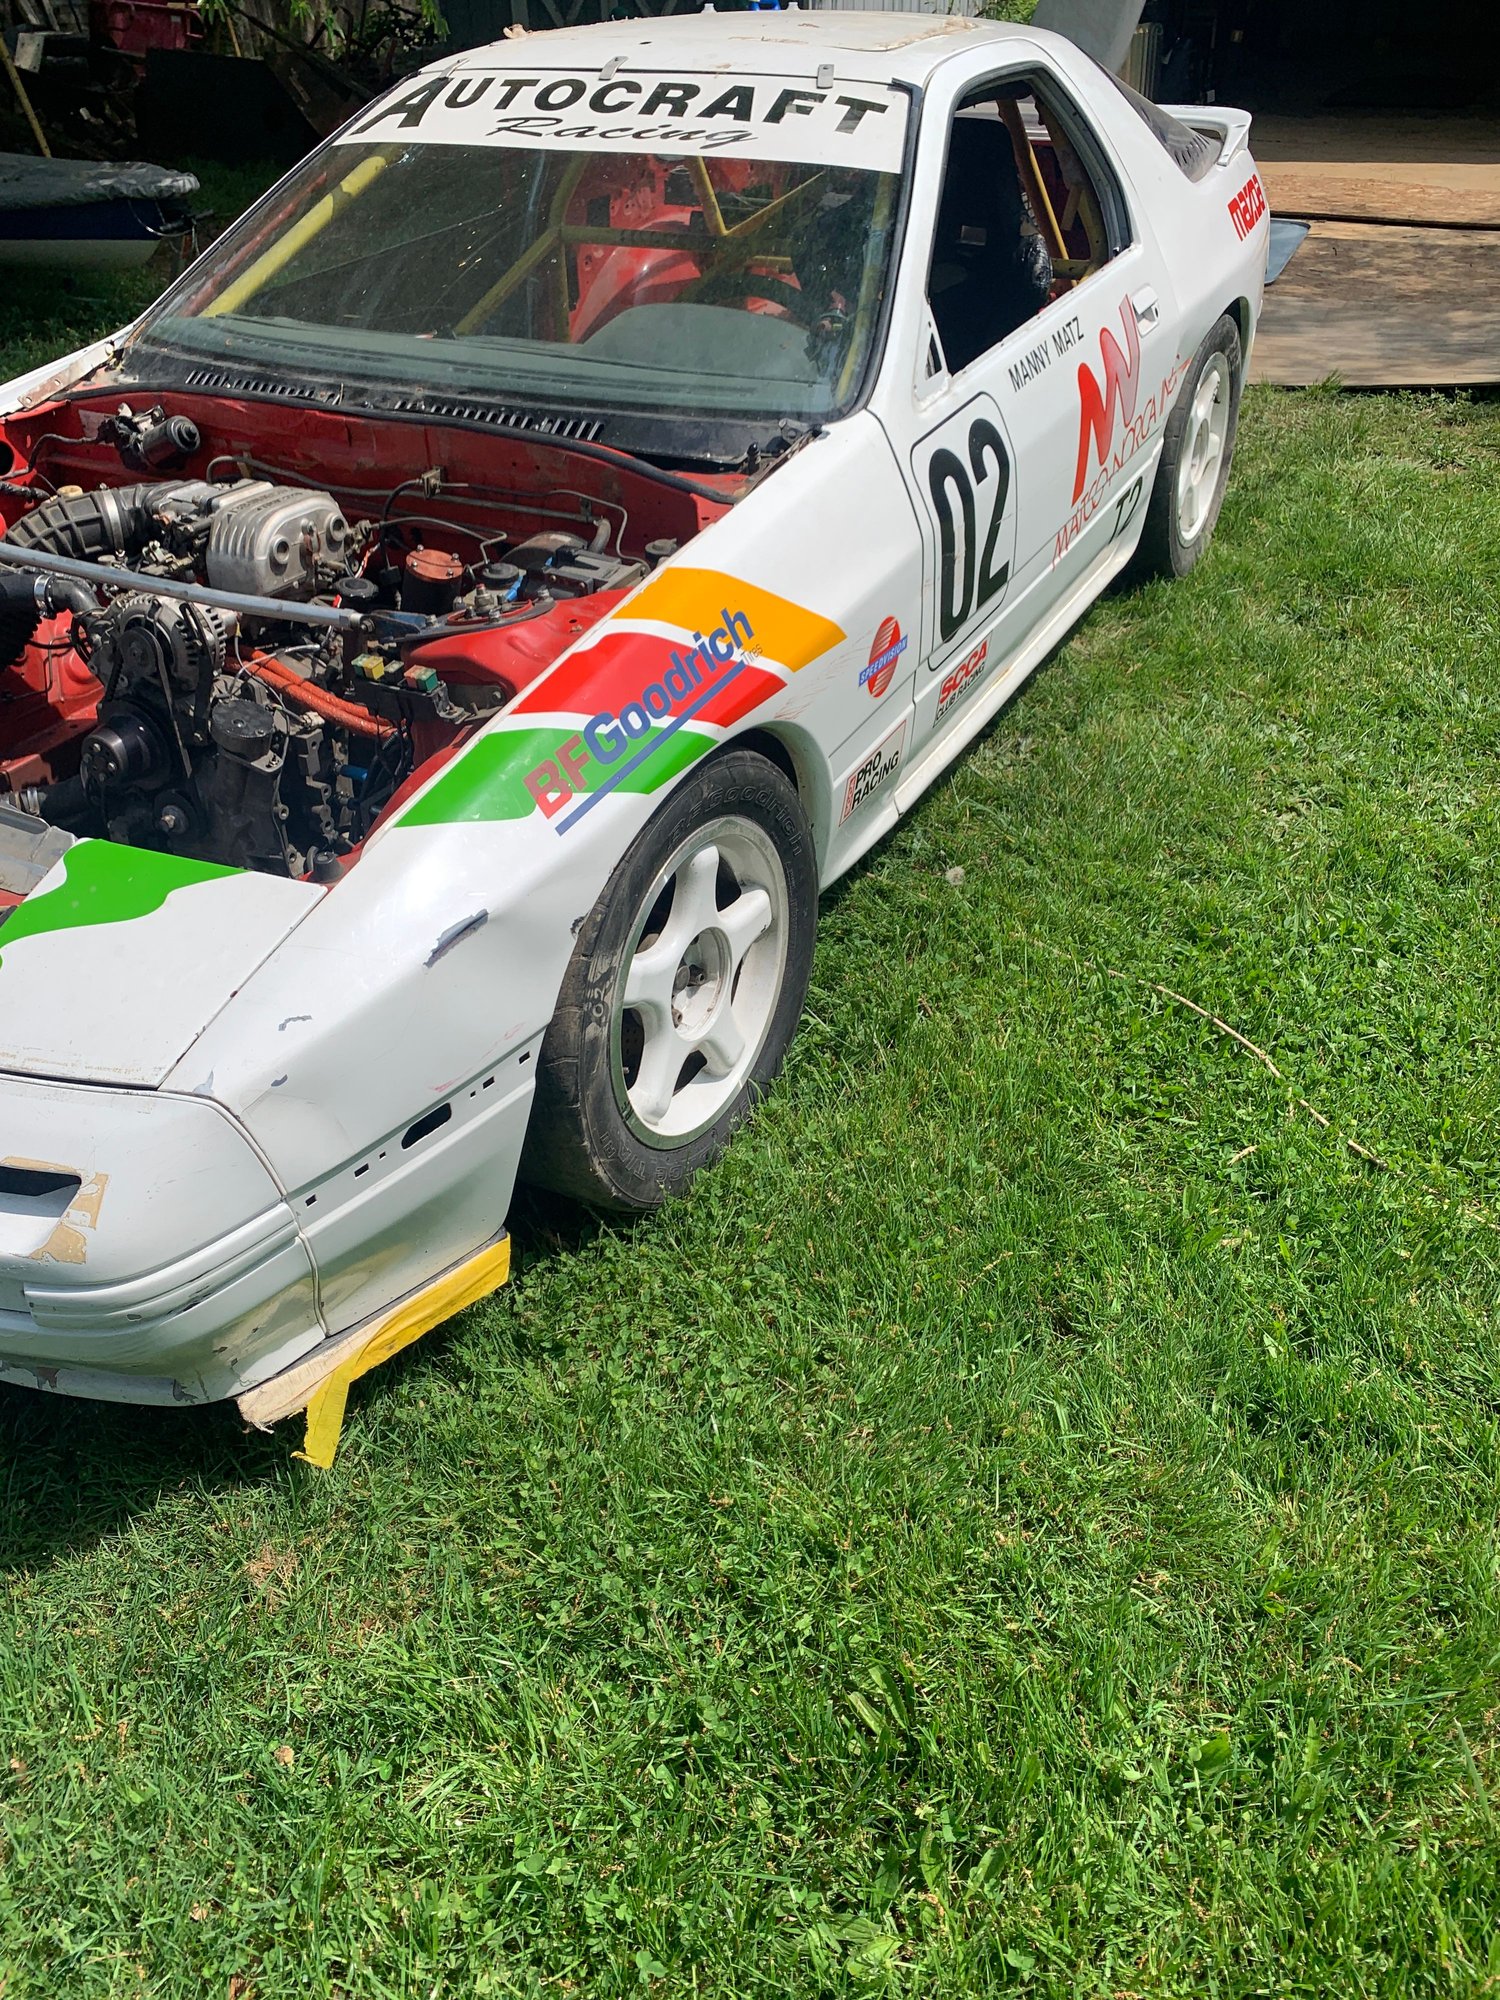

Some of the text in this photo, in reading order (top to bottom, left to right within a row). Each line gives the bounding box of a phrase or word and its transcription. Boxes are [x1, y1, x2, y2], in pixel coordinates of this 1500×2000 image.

[348, 76, 888, 137] AUTOCRAFT
[486, 117, 760, 149] Racing
[1008, 316, 1084, 393] MANNY MATZ
[929, 418, 1010, 643] 02
[859, 639, 907, 684] SPEEDVISION
[939, 639, 988, 704] SCCA
[957, 661, 985, 699] RACING
[523, 608, 755, 820] BFGoodrich
[851, 750, 899, 811] RACING
[855, 750, 882, 791] PRO
